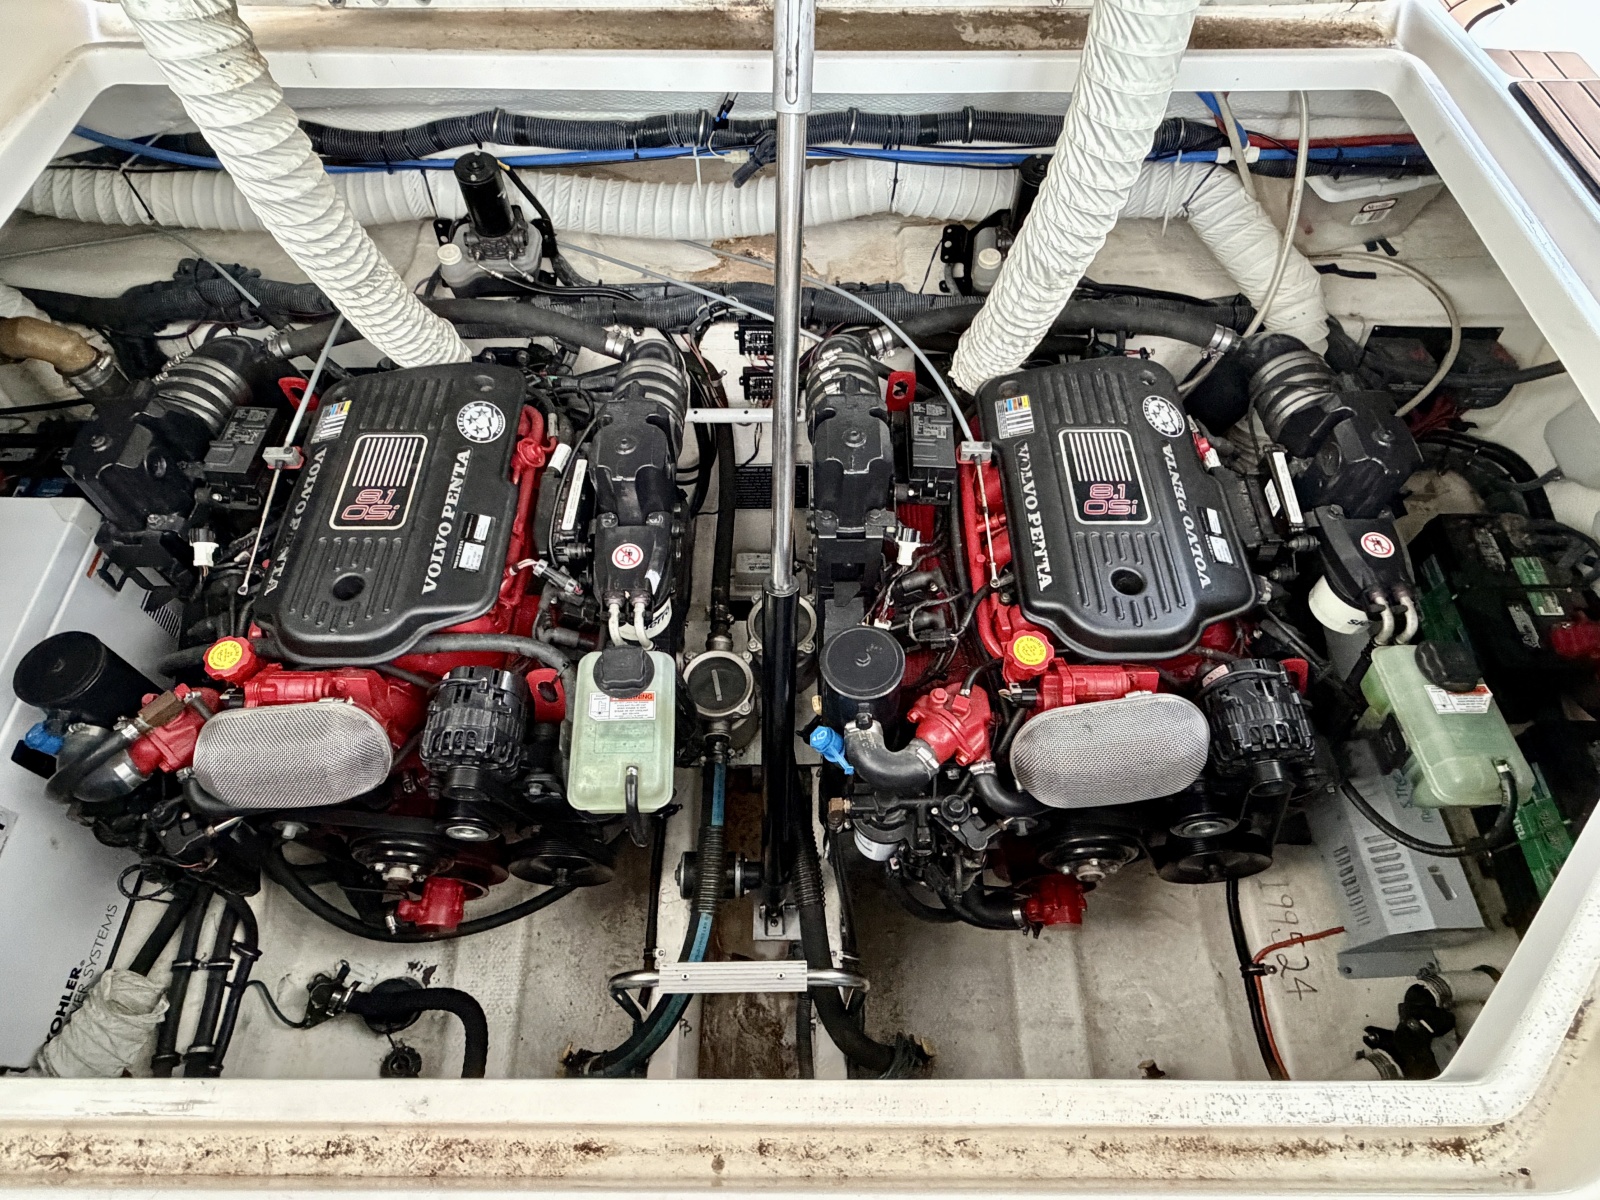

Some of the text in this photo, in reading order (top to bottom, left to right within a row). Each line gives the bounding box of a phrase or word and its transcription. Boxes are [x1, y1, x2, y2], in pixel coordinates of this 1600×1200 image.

[295, 447, 327, 515] VOLVO
[355, 488, 396, 504] 8.1
[1089, 483, 1126, 499] 8.1
[1163, 444, 1189, 513] PENTA
[421, 447, 471, 595] VOLVO PENTA
[1017, 442, 1054, 591] VOLVO PENTA
[1181, 520, 1212, 589] VOLVO
[84, 903, 118, 979] SYSTEMS
